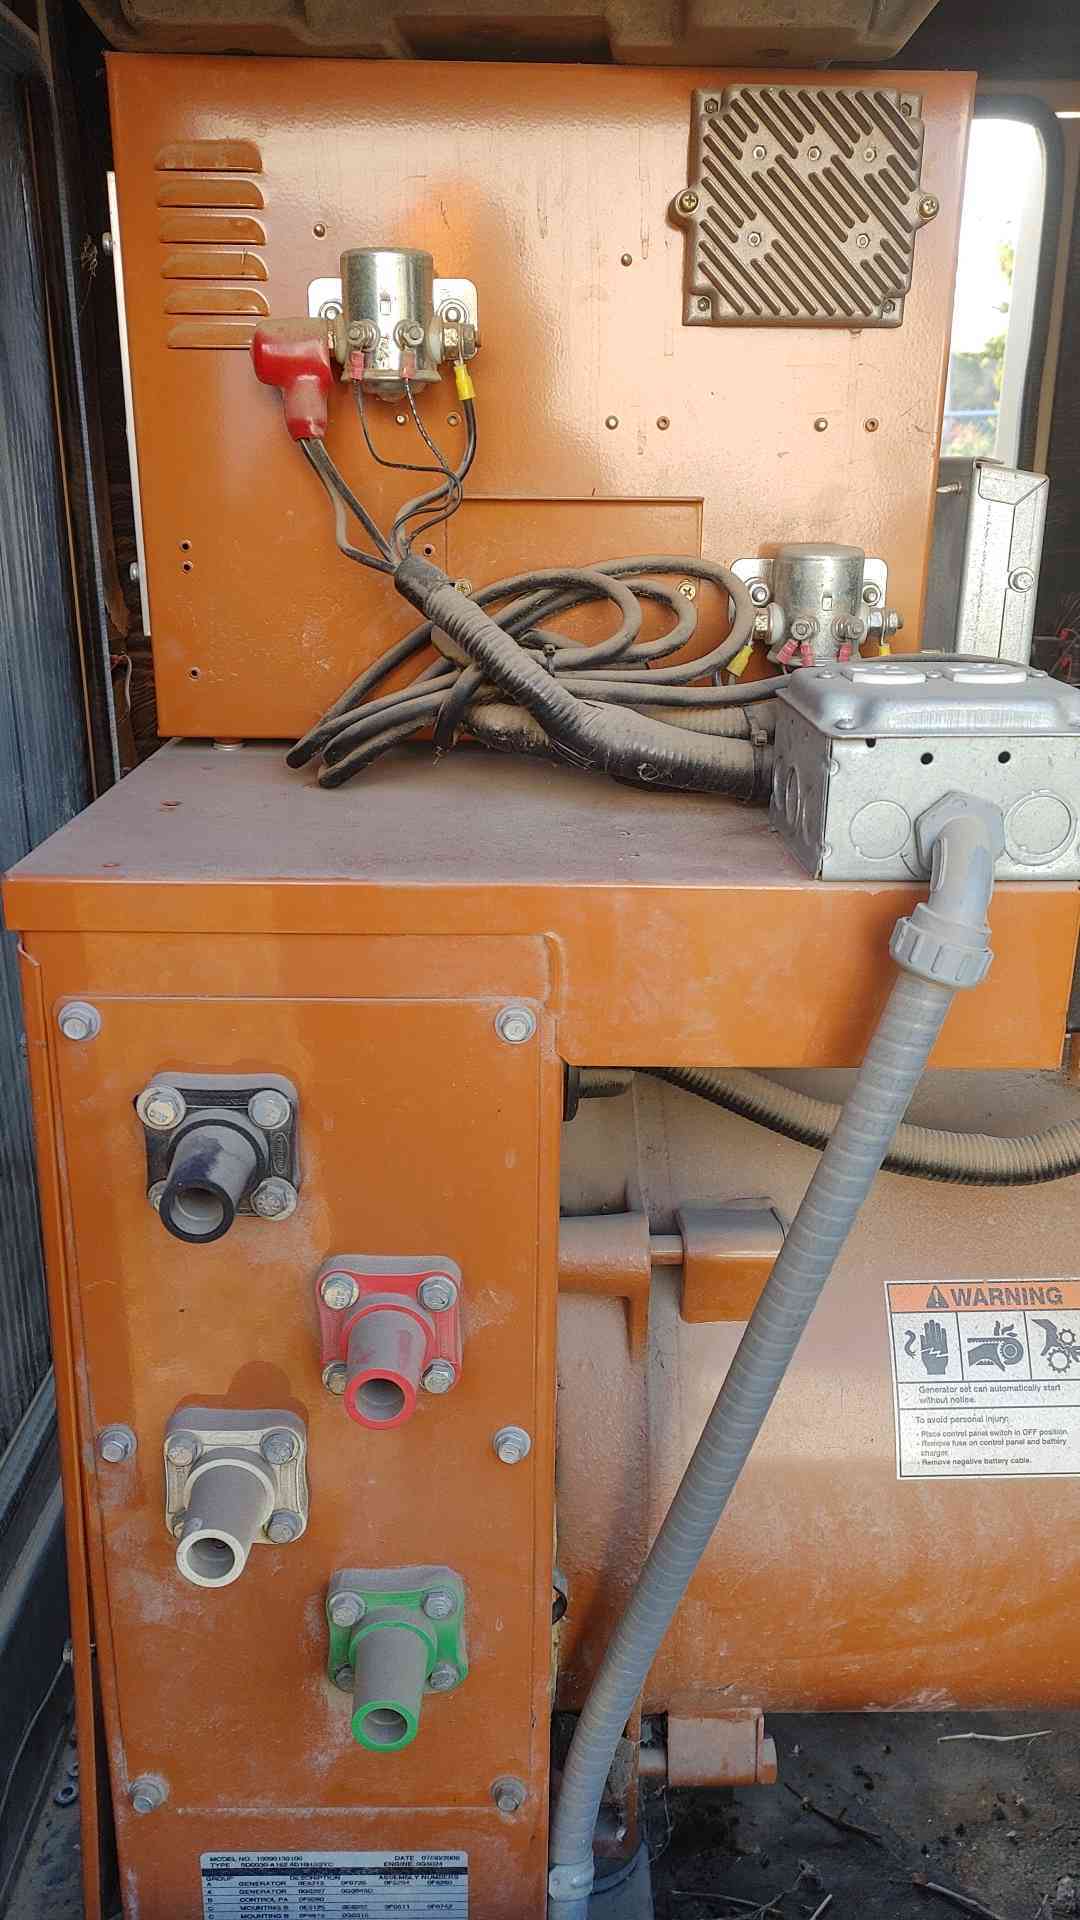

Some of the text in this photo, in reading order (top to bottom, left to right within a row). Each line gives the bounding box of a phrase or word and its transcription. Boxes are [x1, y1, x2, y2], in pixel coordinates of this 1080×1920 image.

[950, 1287, 1063, 1306] WARNING
[918, 1385, 957, 1393] Generator
[960, 1385, 972, 1393] set
[990, 1384, 1041, 1393] automatically
[919, 1396, 949, 1404] without
[916, 1416, 925, 1424] To
[927, 1416, 948, 1424] avoid
[950, 1416, 984, 1425] personal
[921, 1430, 941, 1438] Place
[968, 1430, 988, 1438] panel
[1006, 1439, 1025, 1447] panel
[1042, 1438, 1067, 1446] battery
[952, 1458, 982, 1466] negative
